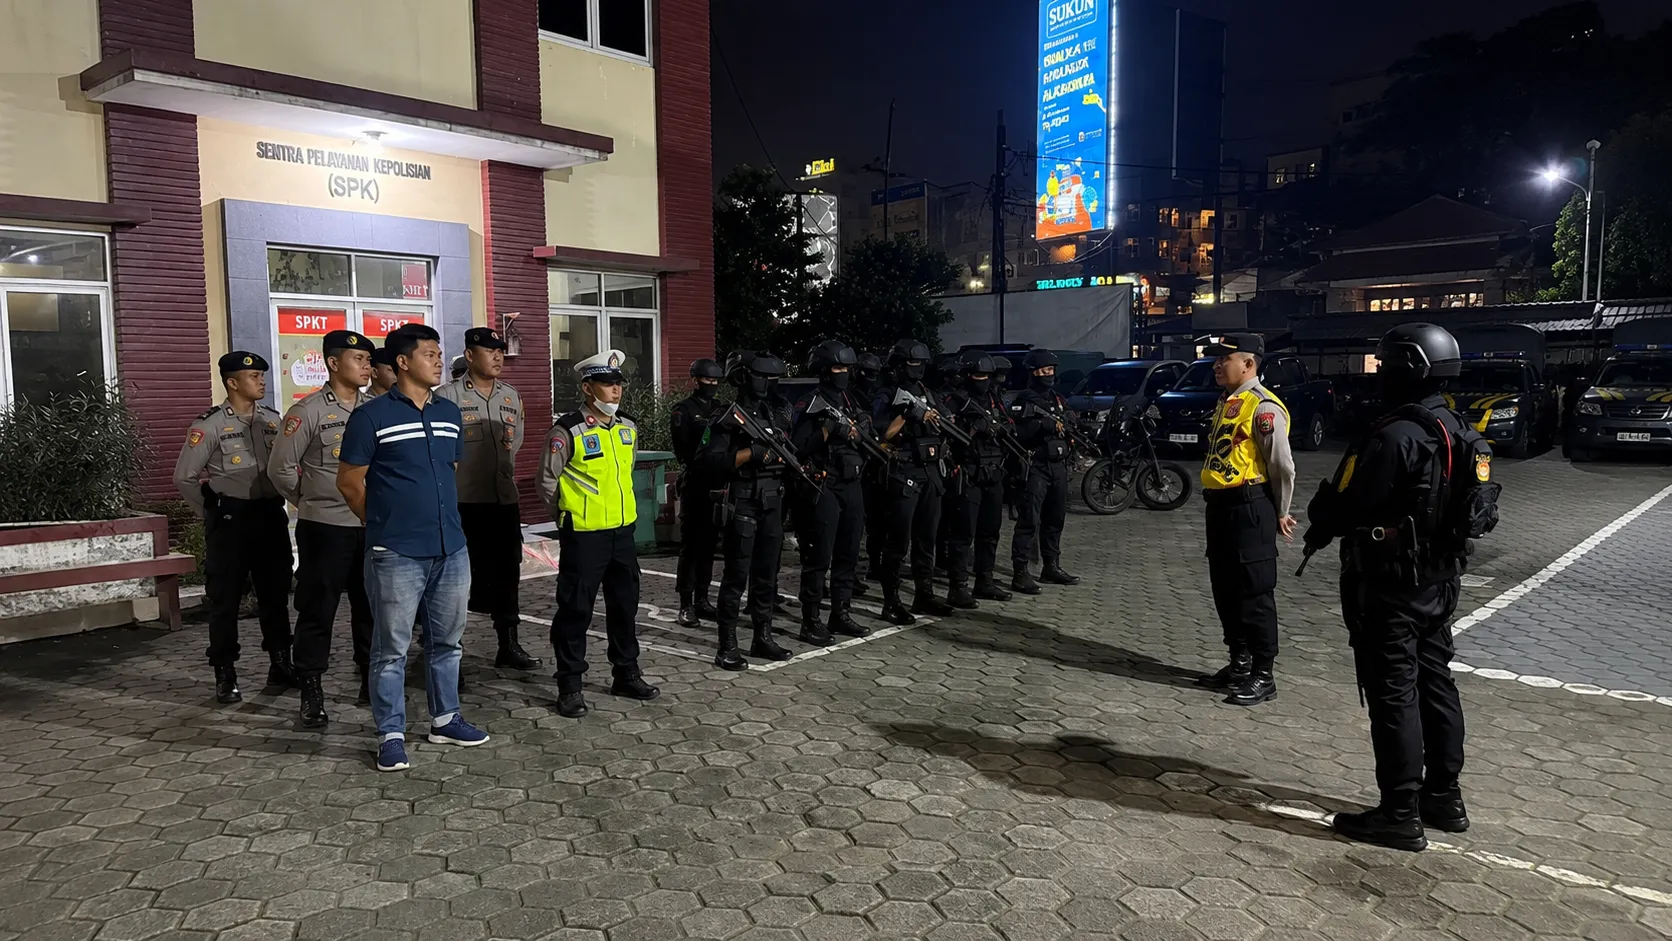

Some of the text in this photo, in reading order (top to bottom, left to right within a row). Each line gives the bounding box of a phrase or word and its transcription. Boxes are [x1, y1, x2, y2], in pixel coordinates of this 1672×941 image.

[1049, 0, 1094, 25] SUKUN
[256, 141, 431, 180] SENTRA PELAYANAN KEPOLISIAN
[328, 172, 380, 204] (SPK)
[295, 315, 328, 330] SPKT
